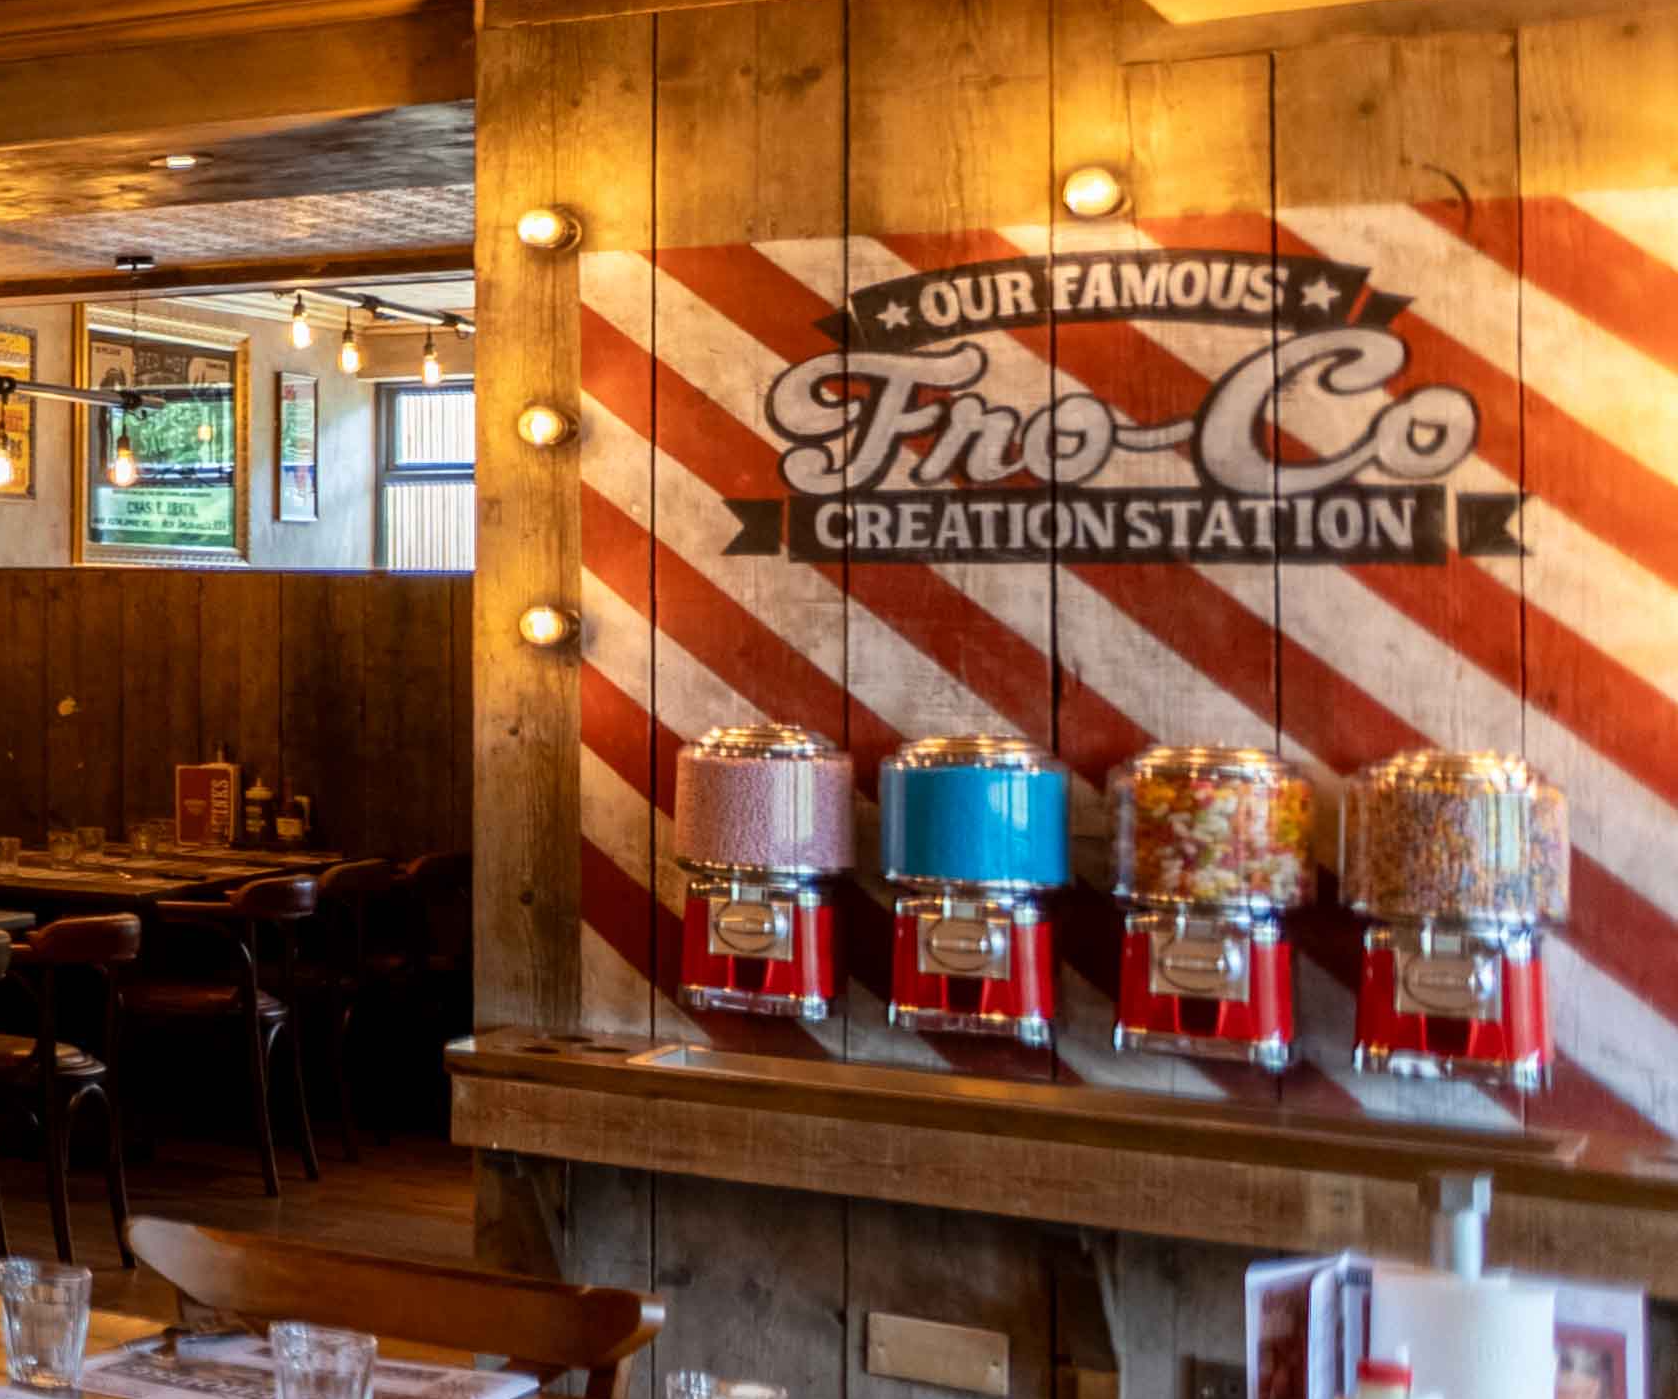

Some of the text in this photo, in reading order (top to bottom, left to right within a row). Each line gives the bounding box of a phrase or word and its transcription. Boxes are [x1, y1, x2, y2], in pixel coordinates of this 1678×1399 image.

[919, 259, 1289, 328] OUR FAMOUS
[814, 496, 1418, 551] CREATION STATION
